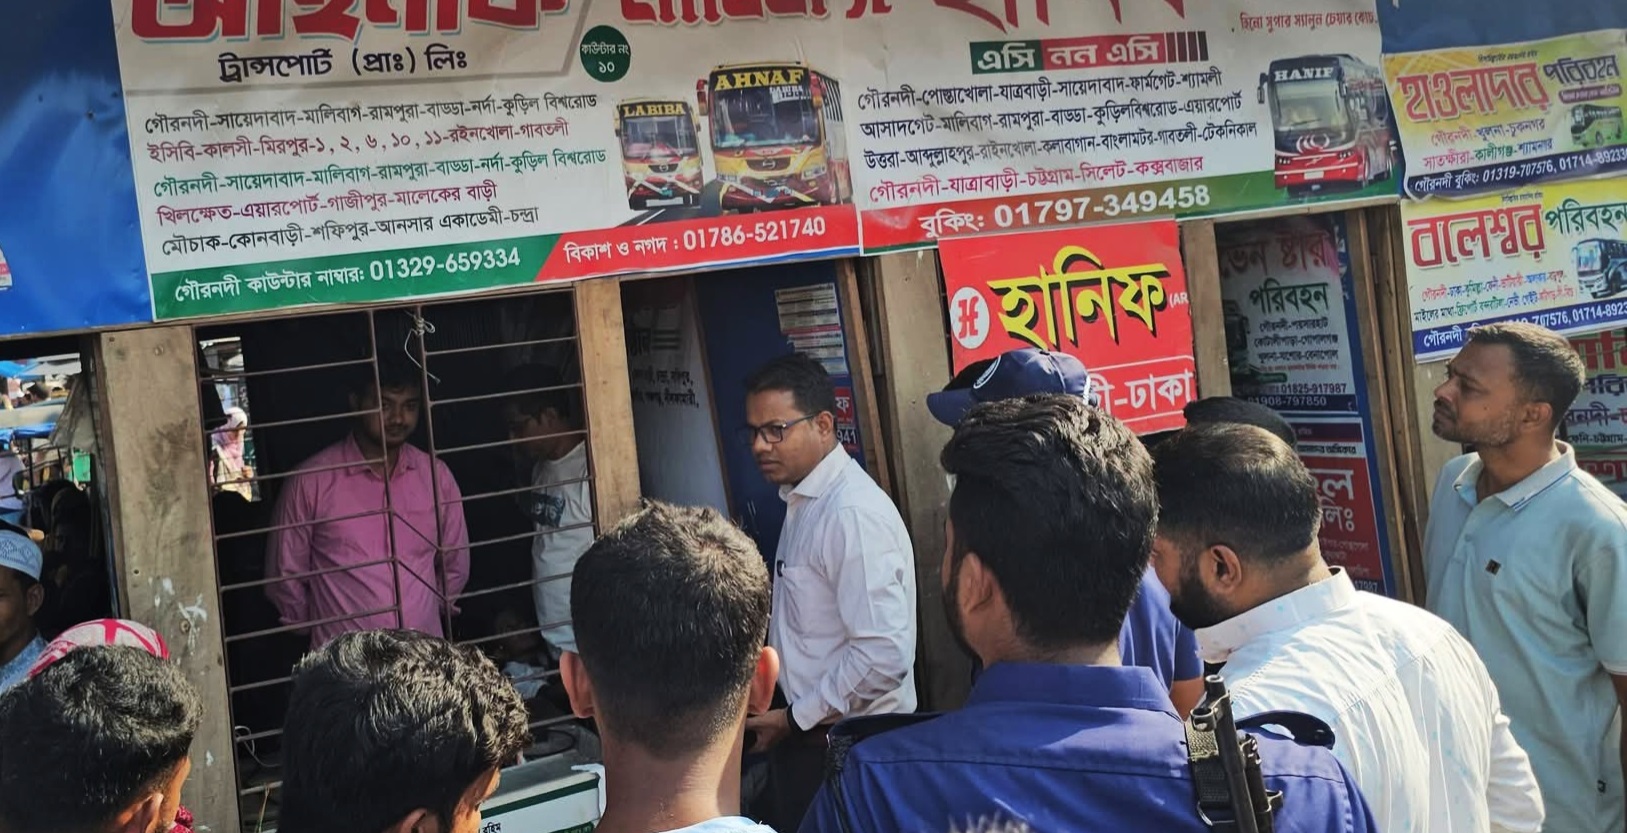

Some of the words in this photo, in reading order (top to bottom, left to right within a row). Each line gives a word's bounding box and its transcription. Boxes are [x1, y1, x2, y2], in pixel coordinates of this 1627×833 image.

[218, 48, 333, 82] ট্রান্সপোর্ট
[425, 44, 467, 70] লিঃ
[618, 43, 630, 54] নং
[977, 41, 1036, 71] এসি
[1047, 45, 1098, 66] নন
[1105, 35, 1162, 63] এসি
[598, 61, 615, 74] ১০
[715, 68, 804, 91] AHNAF
[1274, 67, 1334, 82] HANIF
[544, 91, 597, 111] বিশ্বরোড
[1397, 62, 1549, 120] হাওলাদার
[623, 103, 686, 118] LABIBA
[553, 148, 606, 167] বিশ্বরোড
[1415, 172, 1451, 192] গৌরনদী
[1482, 160, 1556, 183] 01319-707576,
[1559, 148, 1627, 170] 01714-89233
[466, 179, 497, 201] বাড়ী
[918, 208, 985, 237] বুকিং:
[994, 185, 1211, 228] 01797-349458
[563, 241, 612, 264] বিকাশ
[617, 243, 629, 257] ও
[683, 216, 826, 251] 01786-521740
[1407, 203, 1545, 267] বলেশ্বর
[1545, 198, 1627, 235] পরিবহন
[175, 272, 240, 302] গৌরনদী
[247, 268, 312, 294] কাউন্টার
[369, 246, 521, 282] 01329-659334
[986, 245, 1171, 351] হানিফ
[1249, 277, 1329, 314] পরিবহন
[1423, 326, 1463, 347] গৌরনদী
[1281, 382, 1347, 394] 01825-917987
